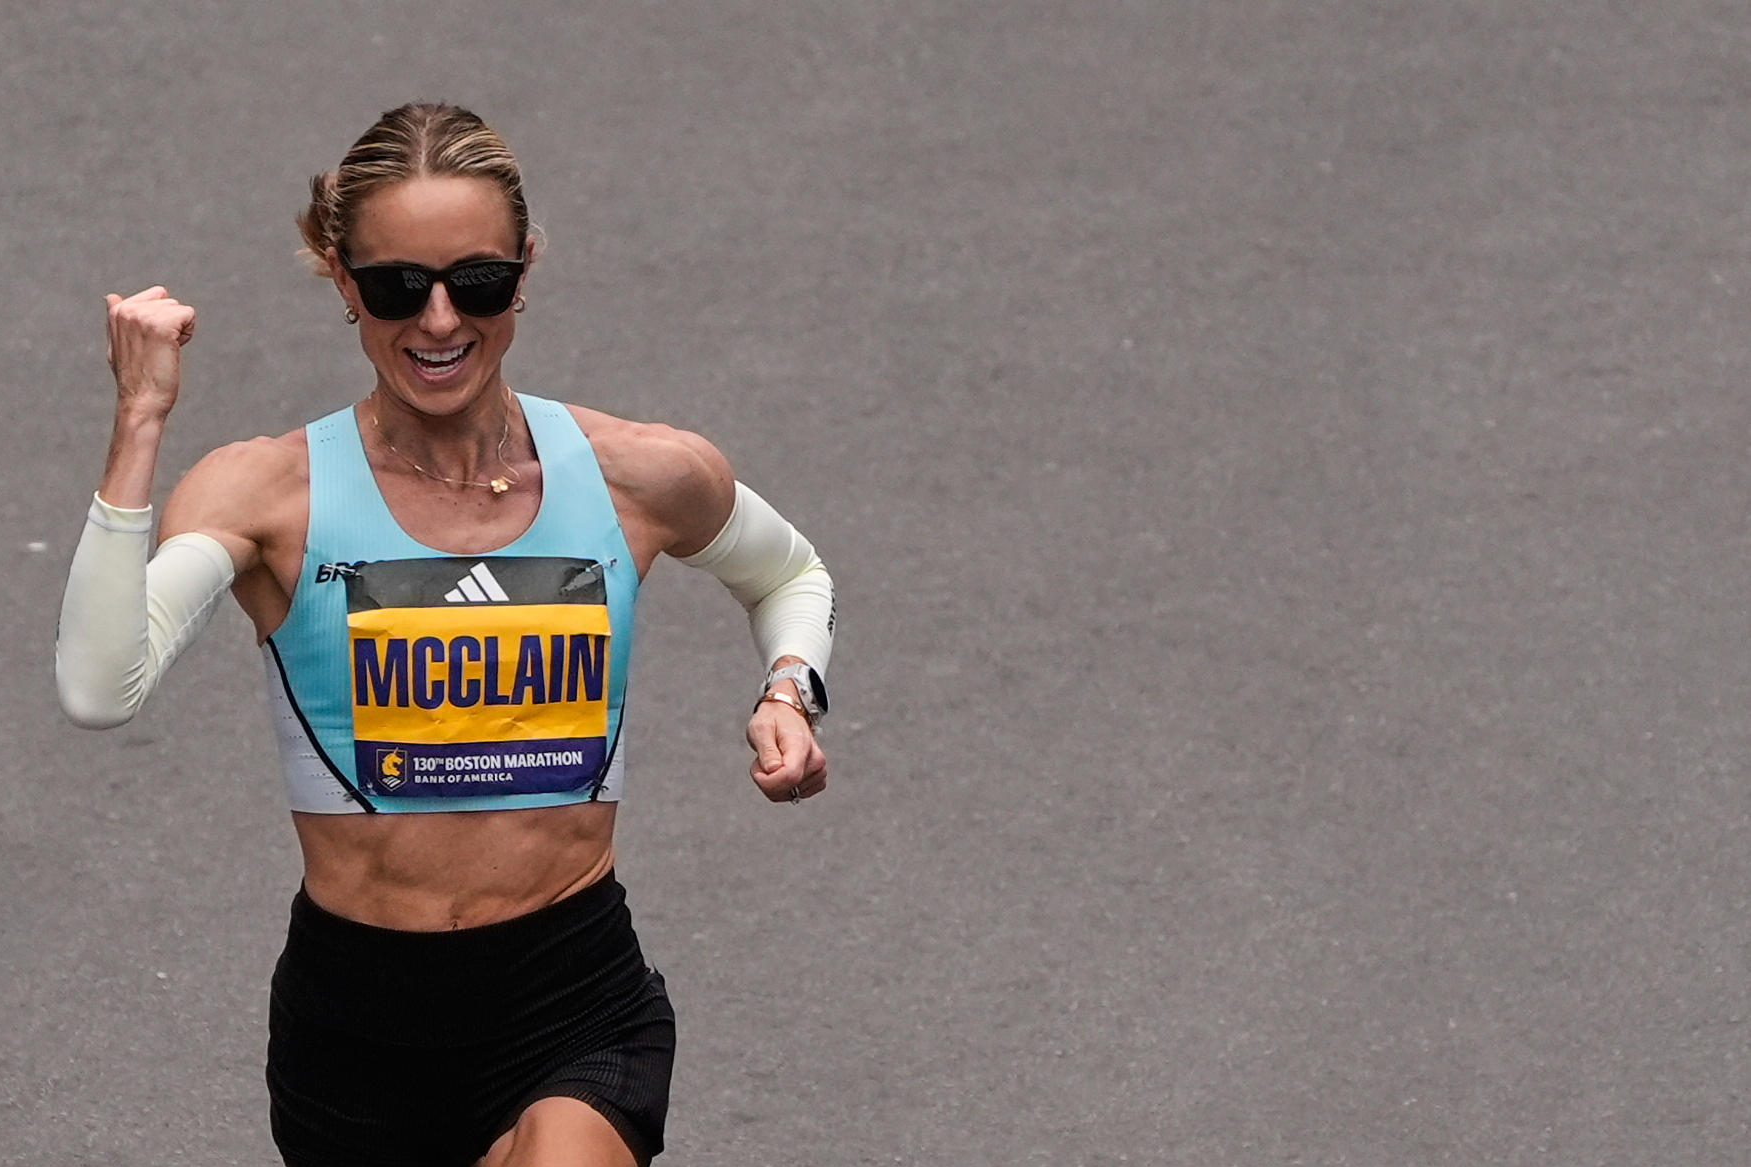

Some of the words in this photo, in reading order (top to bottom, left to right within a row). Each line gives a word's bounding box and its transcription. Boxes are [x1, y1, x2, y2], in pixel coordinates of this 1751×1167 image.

[353, 634, 606, 709] MCCLAIN
[445, 755, 500, 771] BOSTON
[504, 751, 583, 769] MARATHON
[414, 774, 446, 784] BANK
[447, 774, 461, 783] OF
[463, 772, 514, 783] AMERICA
